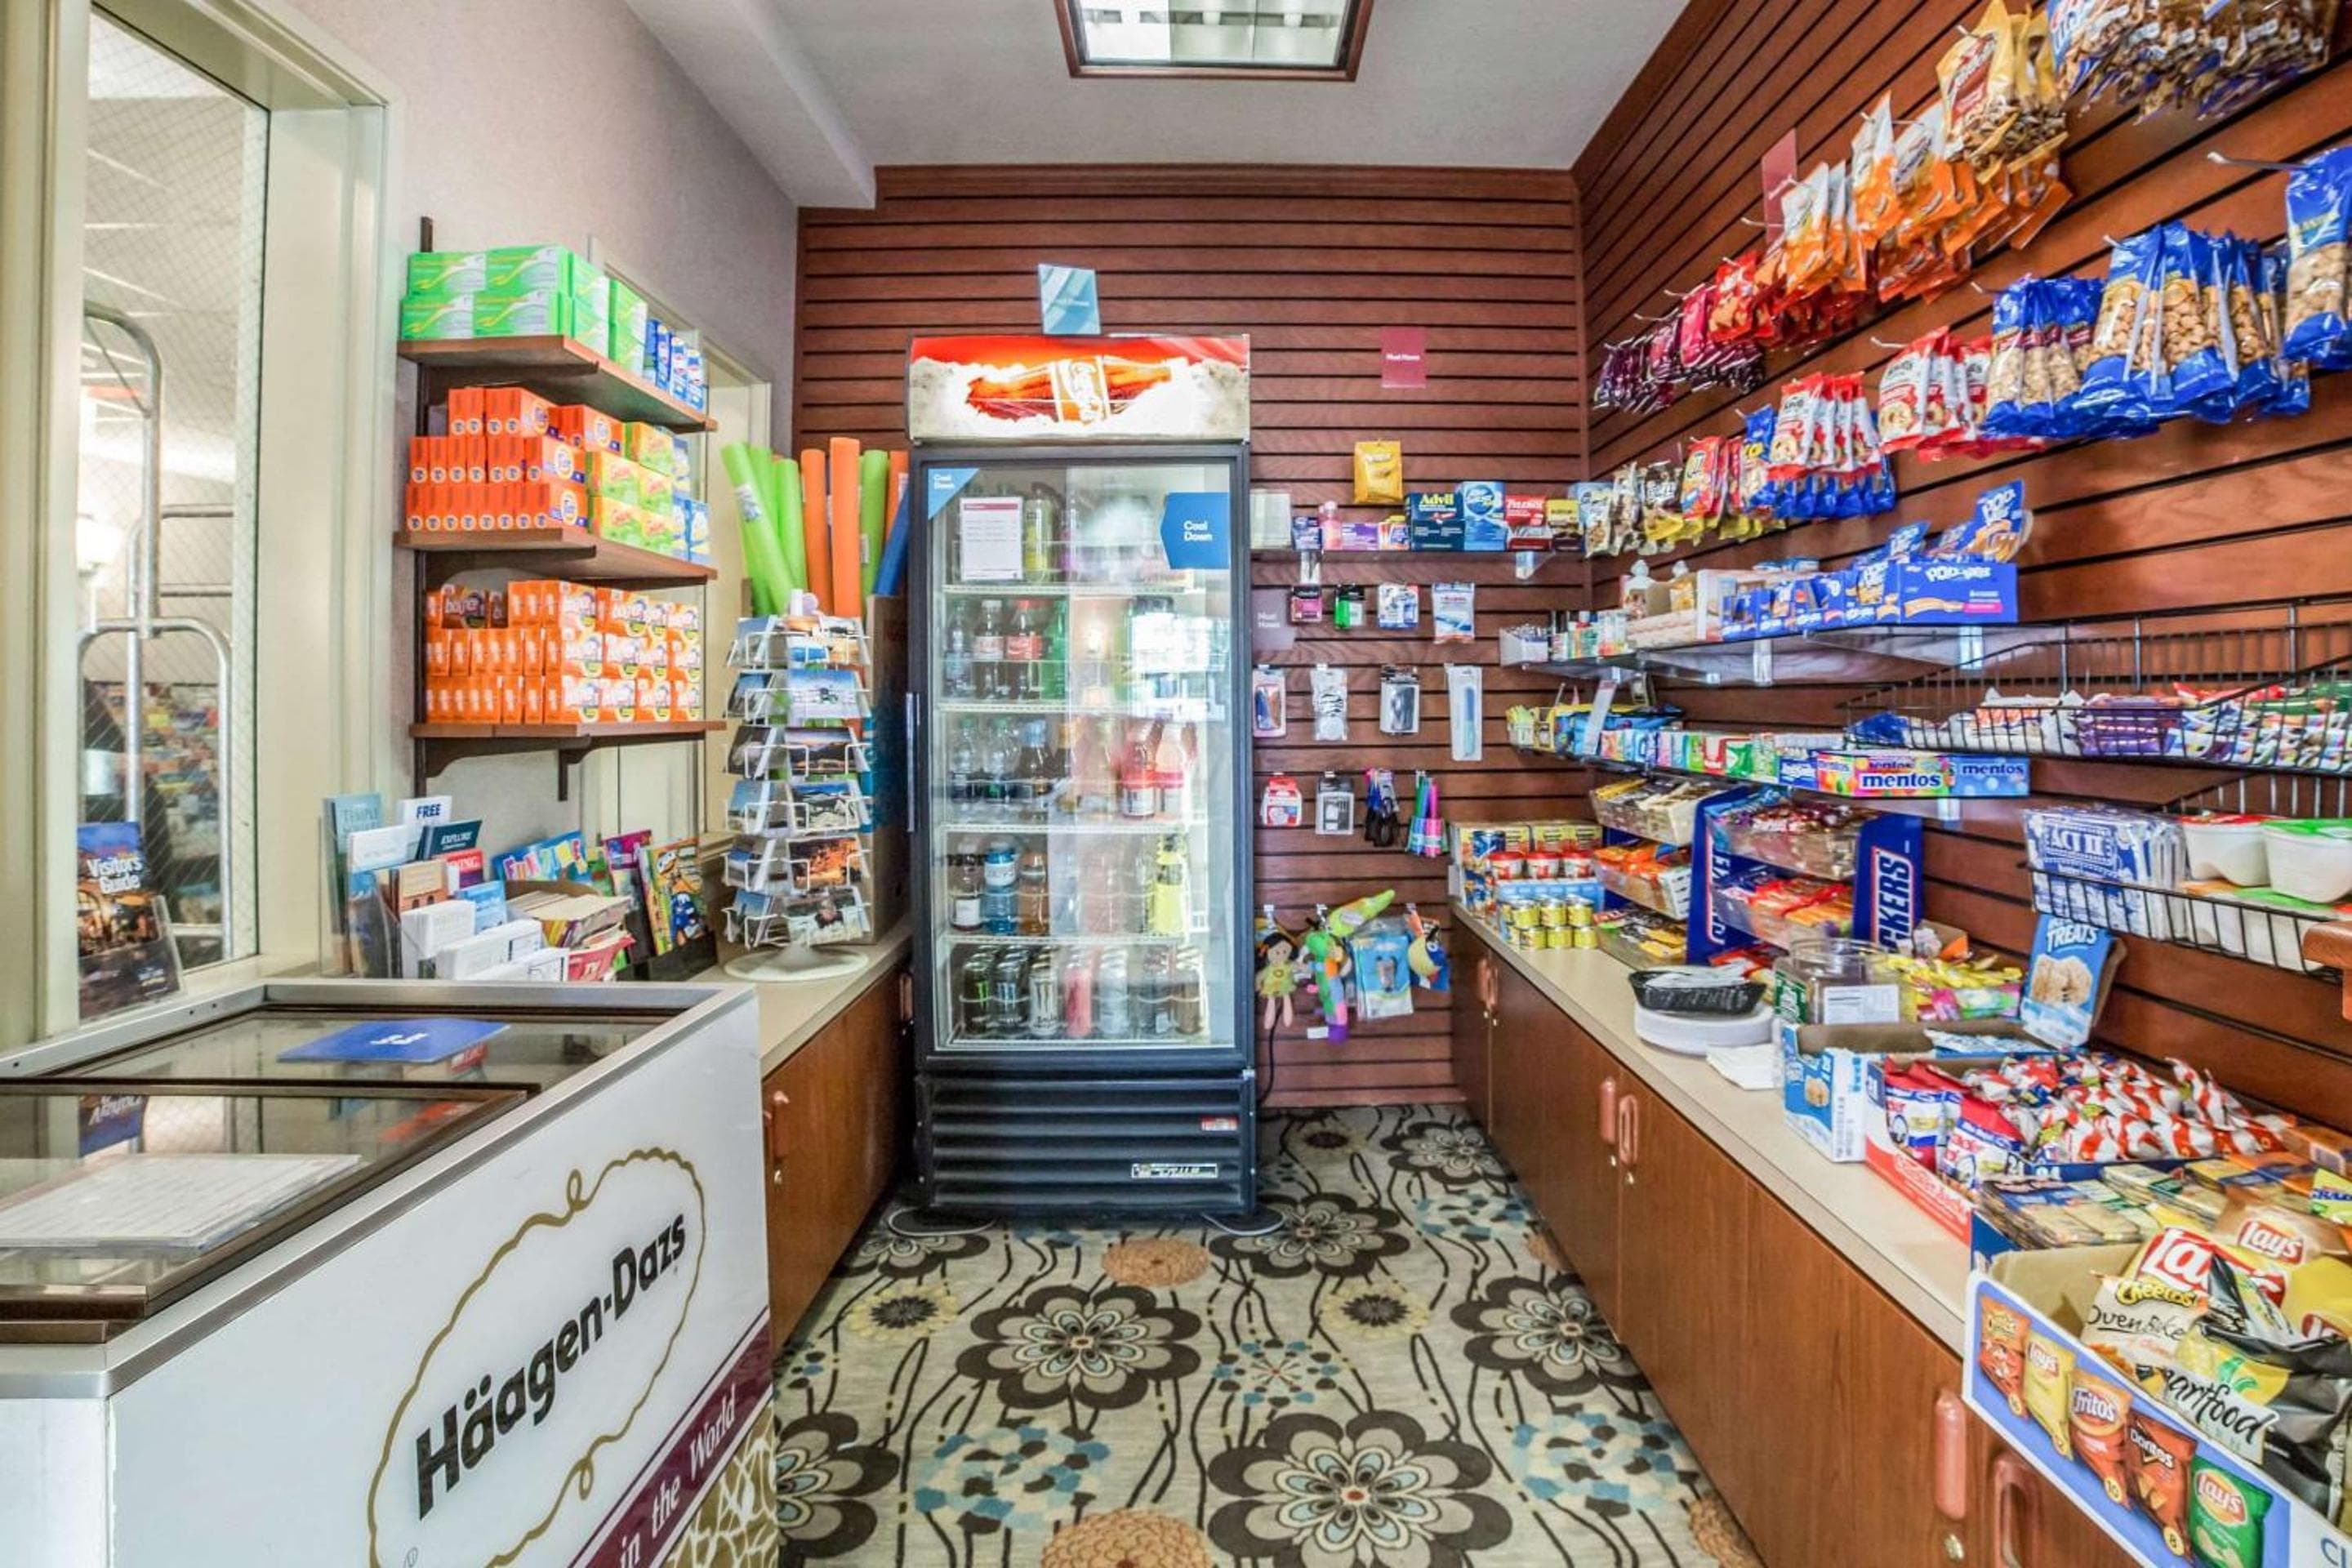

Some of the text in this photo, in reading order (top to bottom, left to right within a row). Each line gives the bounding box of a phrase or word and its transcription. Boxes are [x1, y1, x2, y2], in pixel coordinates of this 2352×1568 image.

[1419, 492, 1454, 506] Advil
[1183, 519, 1209, 531] Cool
[1184, 531, 1214, 541] Down
[1862, 773, 1941, 788] mentos
[1962, 764, 2025, 775] mentos
[416, 803, 442, 820] FREE
[2050, 823, 2081, 853] ACT
[99, 875, 142, 895] Guide
[2047, 924, 2099, 954] TREATS
[2240, 1220, 2303, 1259] Lay's
[2115, 1278, 2198, 1307] Cheetos
[415, 1214, 687, 1521] Häagen-Dazs
[2129, 1428, 2176, 1468] Doritos
[620, 1383, 737, 1568] in the World
